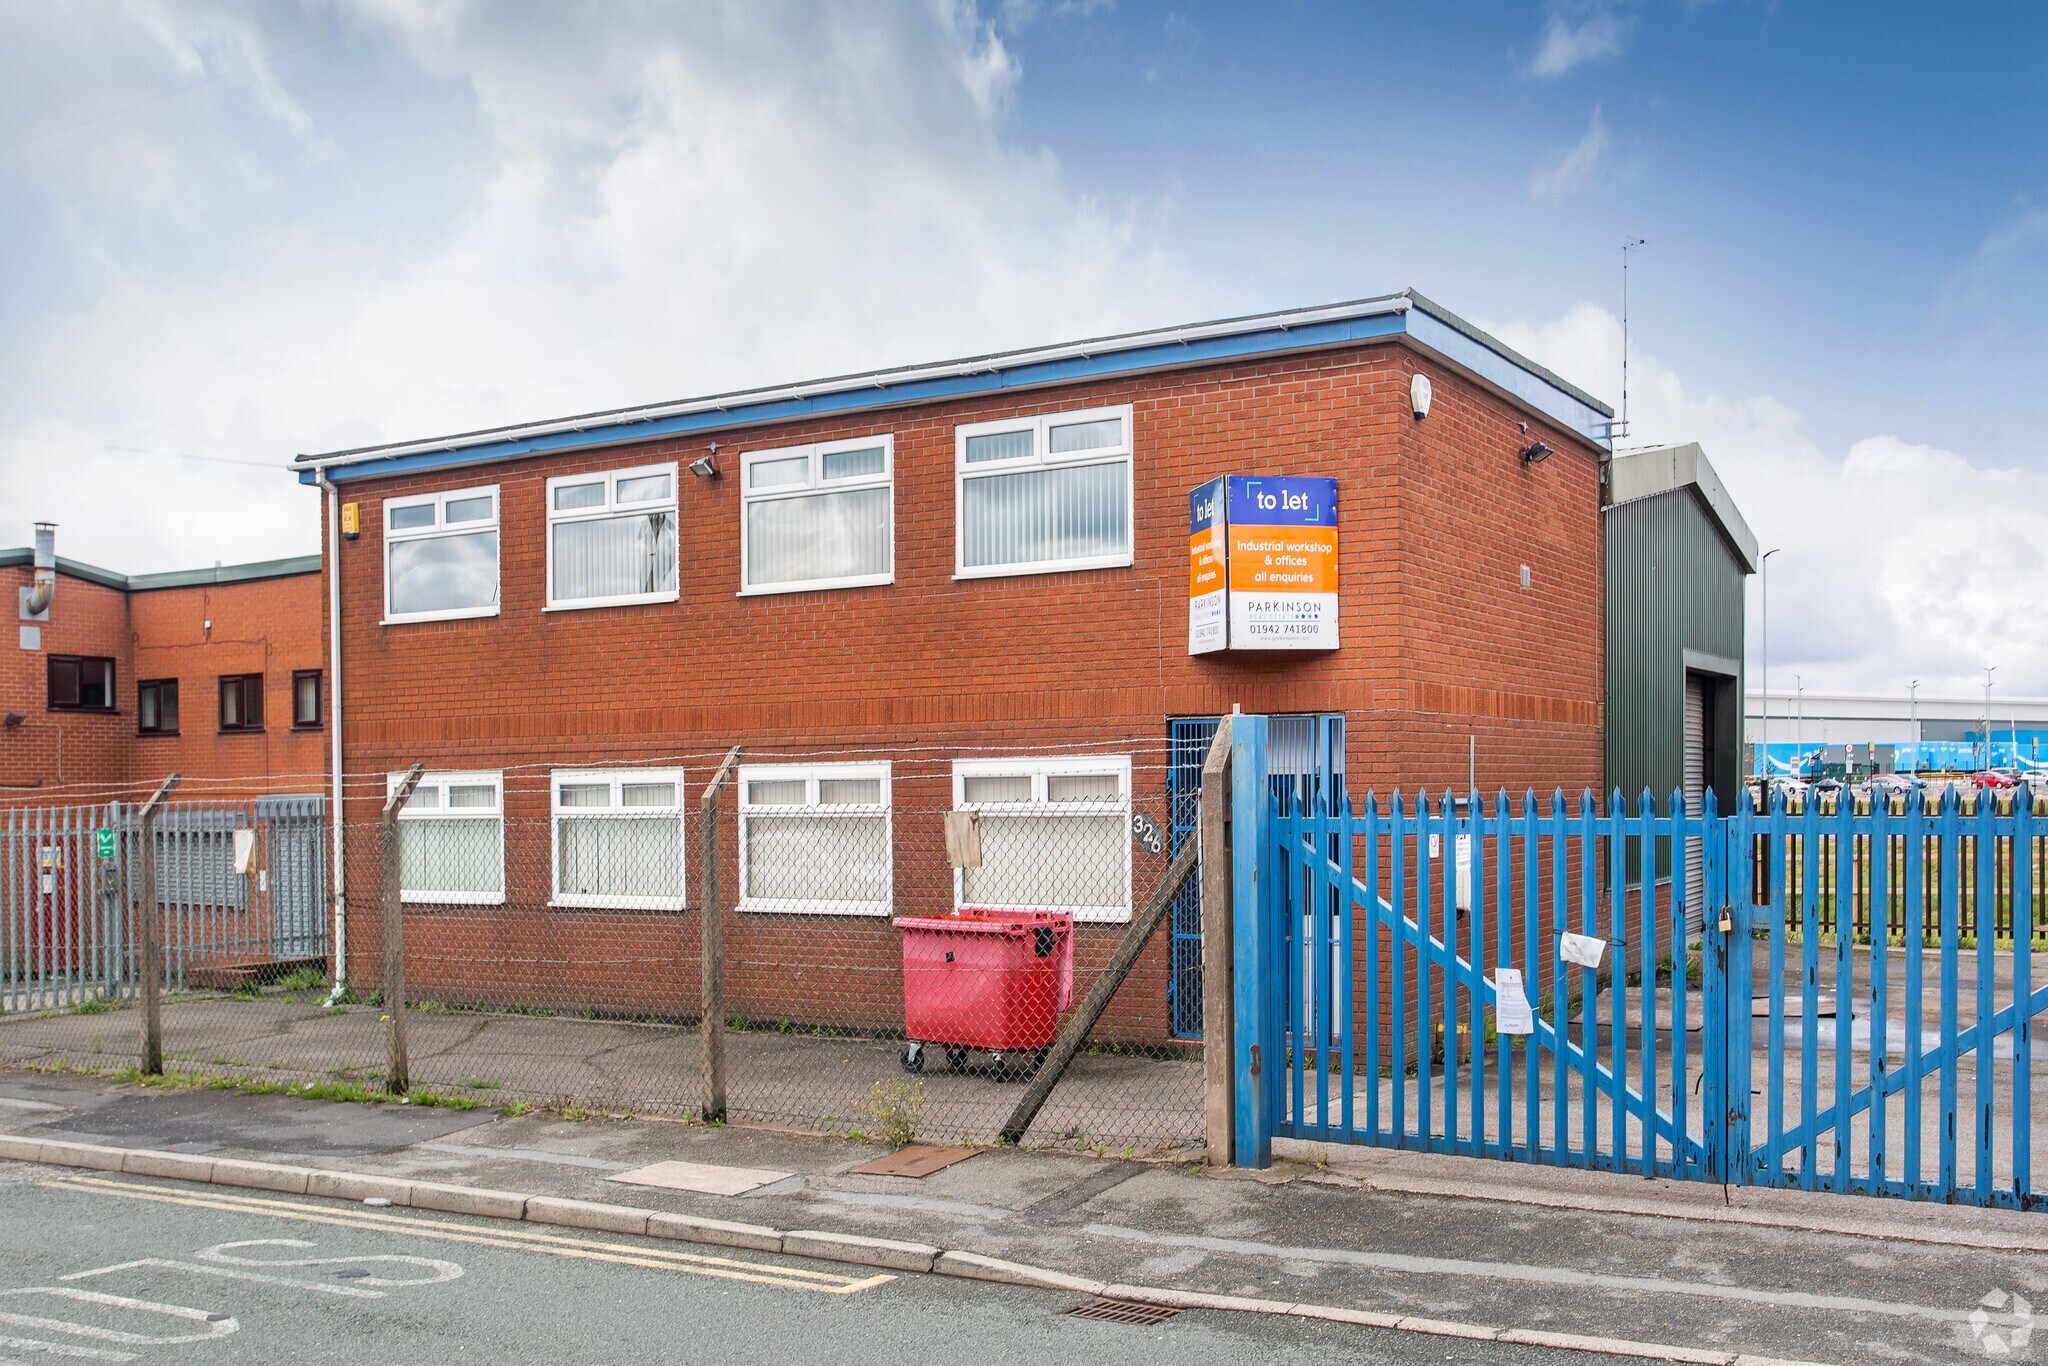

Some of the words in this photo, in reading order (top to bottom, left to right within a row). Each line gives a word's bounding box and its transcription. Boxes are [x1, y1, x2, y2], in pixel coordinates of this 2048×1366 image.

[1256, 490, 1277, 510] to
[1281, 489, 1309, 511] let
[1197, 504, 1204, 522] to
[1204, 498, 1215, 519] let
[1237, 541, 1284, 552] Industrial
[1286, 541, 1333, 555] workshop
[1264, 554, 1273, 566] &
[1275, 555, 1307, 566] offices
[1254, 571, 1267, 582] all
[1269, 571, 1314, 584] enquiries
[1248, 601, 1321, 612] PARKINSON
[1250, 625, 1280, 634] 01942
[1284, 625, 1319, 634] 741800
[1133, 814, 1161, 853] 326
[0, 1238, 465, 1366] SLO
